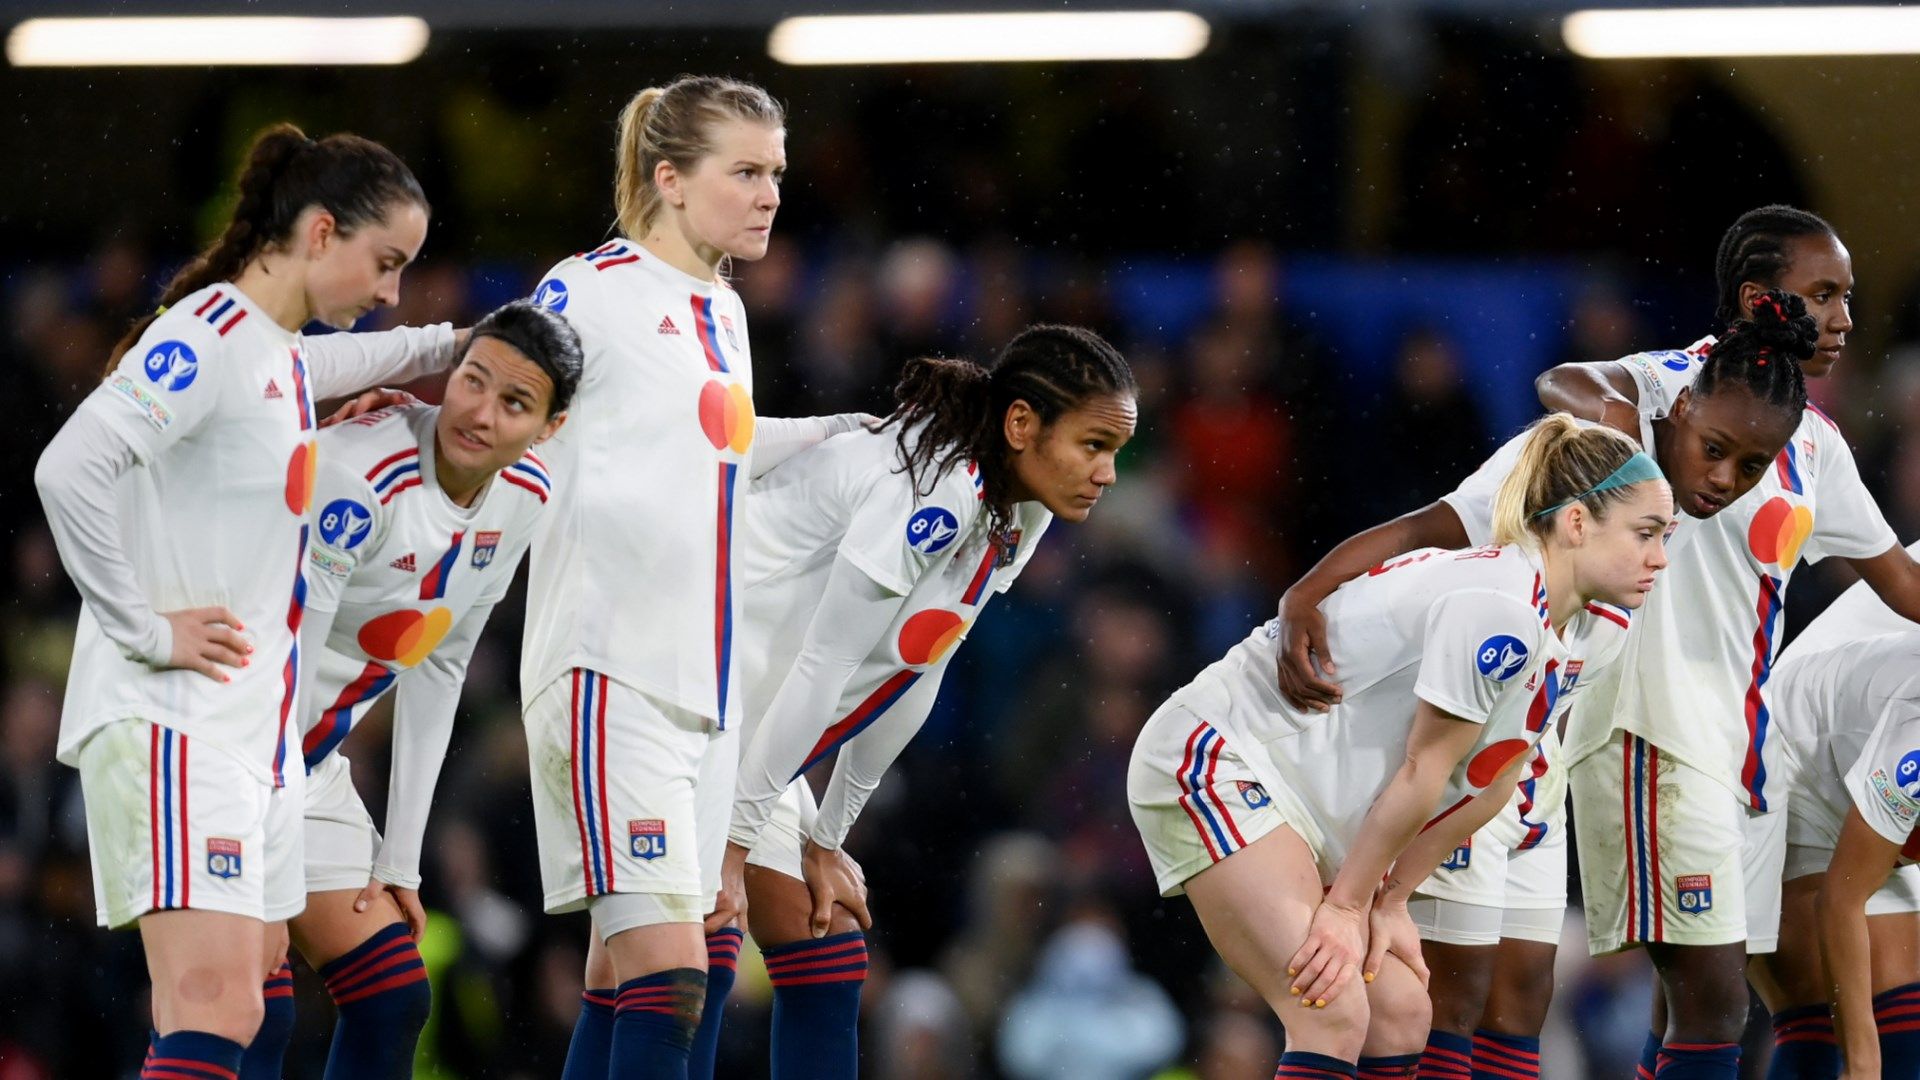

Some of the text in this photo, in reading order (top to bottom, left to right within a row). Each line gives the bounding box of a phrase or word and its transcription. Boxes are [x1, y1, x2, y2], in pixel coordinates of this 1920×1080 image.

[148, 353, 165, 370] 8
[323, 513, 338, 531] 8
[911, 518, 928, 534] 8
[1481, 647, 1498, 664] 8
[1901, 760, 1917, 776] 8
[633, 836, 664, 854] OL
[1681, 891, 1710, 909] OL
